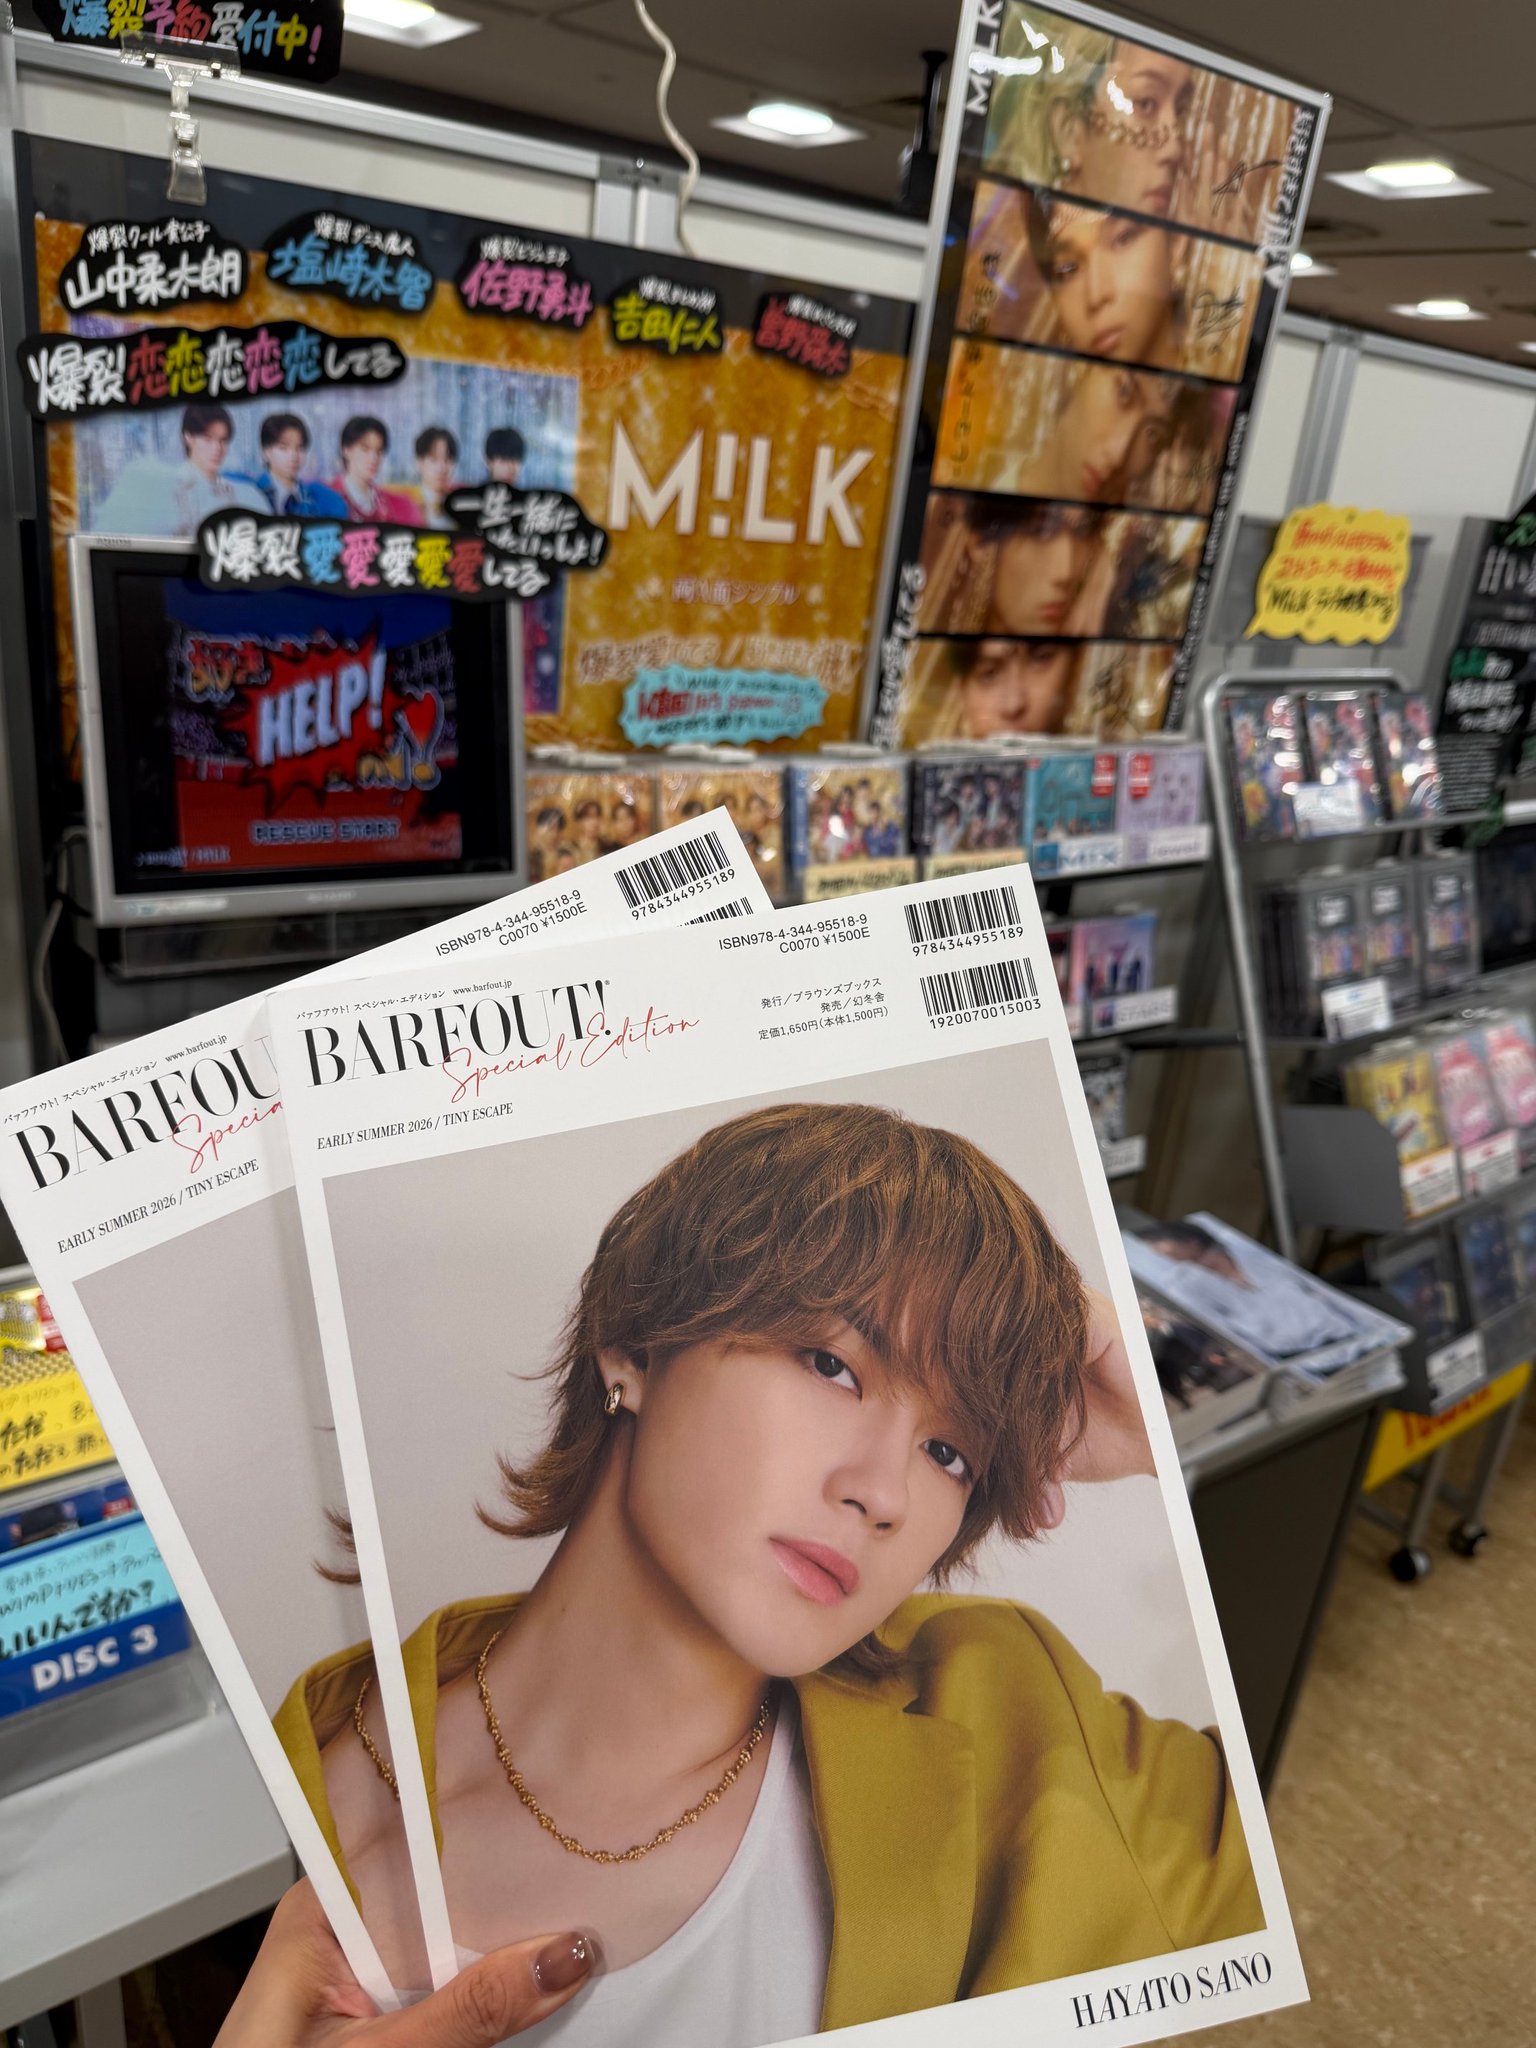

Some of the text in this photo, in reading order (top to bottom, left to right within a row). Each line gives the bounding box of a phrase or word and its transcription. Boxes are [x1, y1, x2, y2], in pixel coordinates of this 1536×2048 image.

[65, 245, 242, 310] 山中柔太朗
[606, 418, 876, 549] M!LK
[257, 649, 387, 767] HELP!
[435, 888, 582, 957] ISBN978-4-344-95518-9
[498, 901, 588, 947] C0070 ¥1500E
[631, 867, 737, 922] 9784344955189
[718, 913, 868, 951] ISBN978-4-344-95518-9
[779, 926, 871, 954] C0070 ¥1500E
[912, 926, 1024, 957] 9784344955189
[354, 989, 446, 1012] スペシャル・エディション
[452, 979, 513, 996] www.barfout.jp
[929, 998, 1042, 1029] 1920070015003
[164, 1033, 229, 1063] www.barfout.jp
[297, 979, 609, 1088] BARFOUT!
[441, 1005, 700, 1104] Special Edition
[317, 1102, 514, 1150] EARLY SUMMER 2026 / TINY ESCAPE
[57, 1158, 260, 1254] EARLY SUMMER 2026 / TINY ESCAPE
[31, 1623, 159, 1693] DISC 3
[1069, 1951, 1272, 2028] HAYATO SANO
